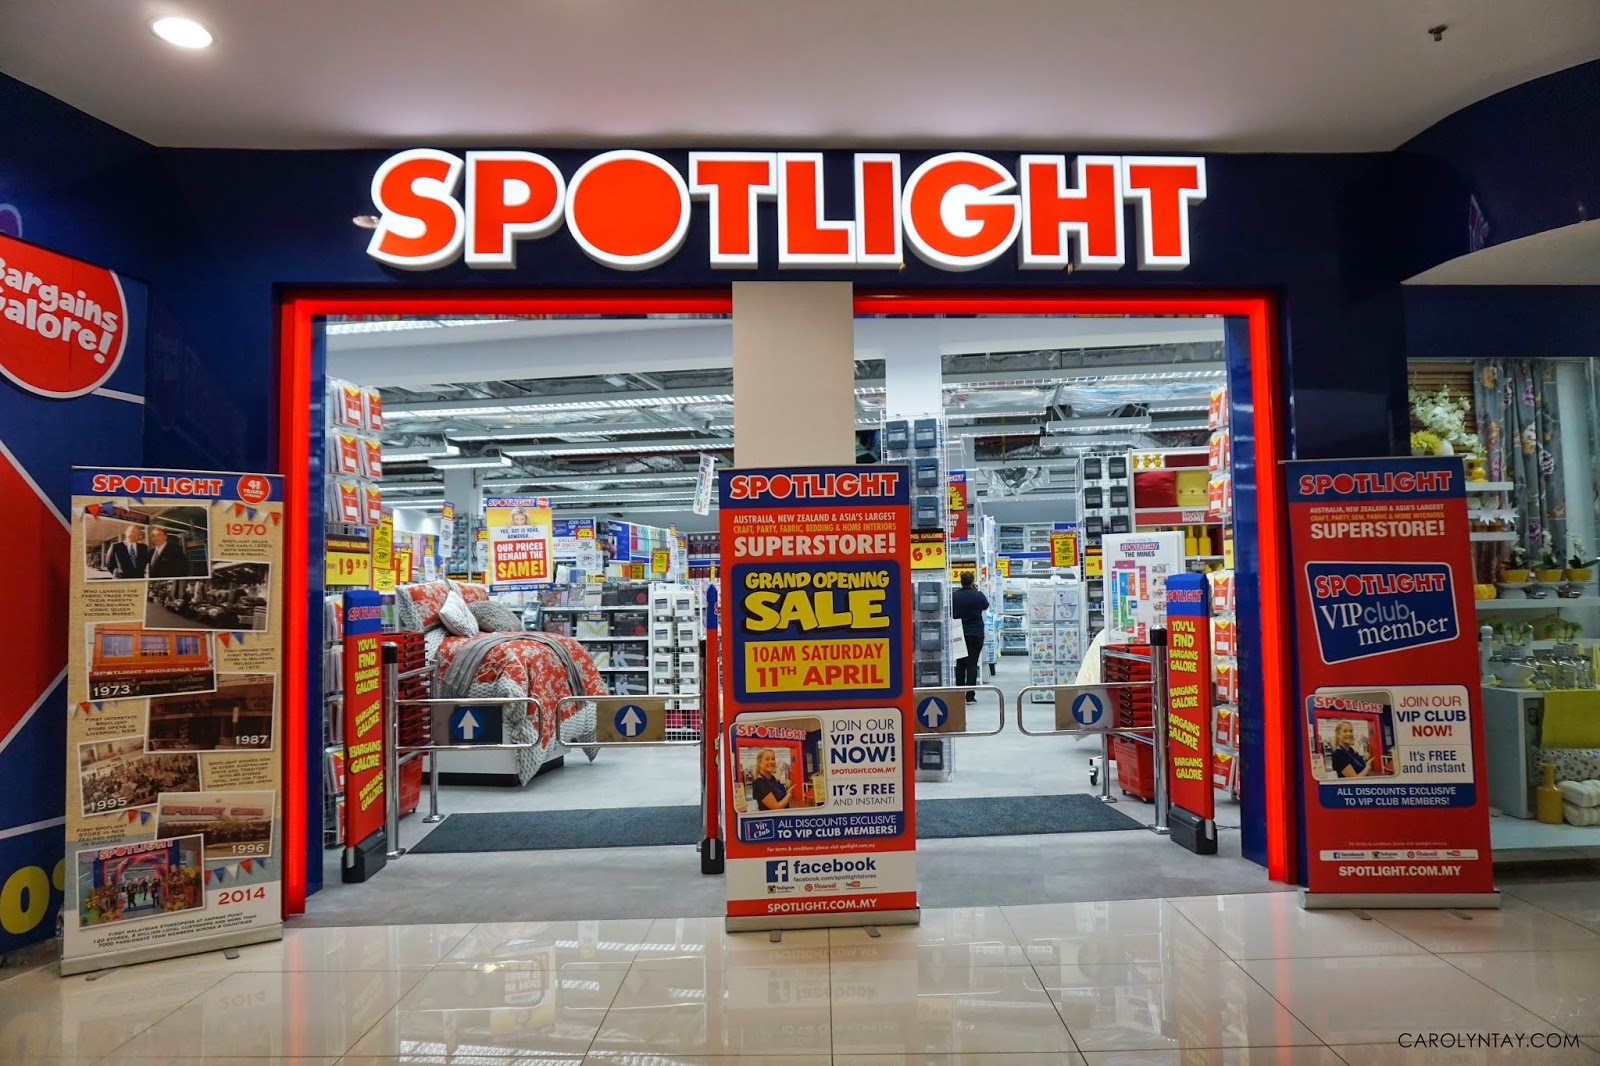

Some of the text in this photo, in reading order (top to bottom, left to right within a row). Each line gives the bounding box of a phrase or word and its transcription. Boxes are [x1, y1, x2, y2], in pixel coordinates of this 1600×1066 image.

[366, 148, 1208, 271] SPOTLIGHT
[92, 474, 224, 496] SPOTLIGHT
[729, 472, 899, 500] SPOTLIGHT
[1299, 470, 1453, 495] SPOTLIGHT
[488, 498, 535, 507] SPOTLIGHT
[733, 512, 896, 524] AUSTRALIA, NEW ZEALAND & ASIA'S LARGEST
[1413, 511, 1445, 519] INTERIORS
[225, 523, 267, 536] 1970
[733, 522, 897, 534] CRAFT, PARTY, FABRIC, BEDDING & HOME INTERIORS
[1310, 520, 1446, 539] SUPERSTORE!
[496, 541, 543, 552] OUR PRICES
[733, 532, 897, 557] SUPERSTORE!
[1121, 543, 1159, 551] SPOTLIGHT
[498, 551, 544, 561] REMAIN THE
[912, 547, 923, 561] 6
[498, 559, 544, 579] SAME!
[745, 570, 890, 590] GRAND OPENING
[1314, 573, 1446, 599] SPOTLIGHT
[348, 605, 382, 621] SPOTLIGHT
[744, 589, 891, 632] SALE
[1171, 620, 1196, 633] YOU'LL
[1357, 611, 1449, 646] member
[357, 636, 377, 652] YOU'LL
[1172, 633, 1194, 649] FIND
[752, 643, 884, 663] 10AM SATURDAY
[1168, 648, 1198, 661] BARGAINS
[358, 652, 377, 669] FIND
[1170, 660, 1197, 673] GALORE
[354, 667, 379, 682] BARGAINS
[756, 664, 884, 688] 11TH APRIL
[93, 684, 131, 697] 1973
[355, 679, 379, 695] GALORE
[1169, 684, 1198, 698] BARGAINS
[1171, 696, 1198, 710] GALORE
[1314, 696, 1384, 714] SPOTLIGHT
[1400, 696, 1462, 708] JOIN OUR
[355, 700, 380, 727] BARGAINS
[1396, 710, 1467, 723] VIP CLUB
[357, 713, 380, 739] GALORE
[736, 723, 806, 741] SPOTLIGHT
[830, 718, 894, 733] JOIN OUR
[1411, 725, 1453, 737] NOW!
[234, 735, 268, 744] 1987
[830, 732, 896, 745] VIP CLUB
[830, 746, 896, 764] NOW!
[1409, 750, 1457, 762] It's FREE
[350, 754, 380, 774] GALORE
[1174, 756, 1203, 770] BARGAINS
[1402, 762, 1466, 774] and instant
[831, 766, 896, 775] SPOTLIGHT.COM.MY
[1175, 767, 1203, 781] GALORE
[358, 770, 384, 801] BARGAINS
[832, 783, 895, 796] IT'S FREE
[1337, 786, 1457, 796] ALL DISCOUNTS EXCLUSIVE
[90, 797, 128, 811] 1995
[360, 784, 384, 812] GALORE
[833, 796, 895, 807] AND INSTANT!
[1344, 796, 1450, 806] TO VIP CLUB MEMBERS!
[778, 815, 897, 829] ALL DISCOUNTS EXCLUSIVE
[753, 828, 771, 839] Club
[777, 825, 897, 839] TO VIP CLUB MEMBERS!
[99, 839, 174, 860] SPOTLIGHT
[231, 843, 265, 854] 1996
[793, 857, 877, 874] facebook
[1338, 865, 1462, 877] SPOTLIGHT.COM.MY
[793, 874, 877, 882] facebook.com/spotlightstores
[217, 886, 266, 906] 2014
[767, 898, 878, 913] SPOTLIGHT.COM.MY
